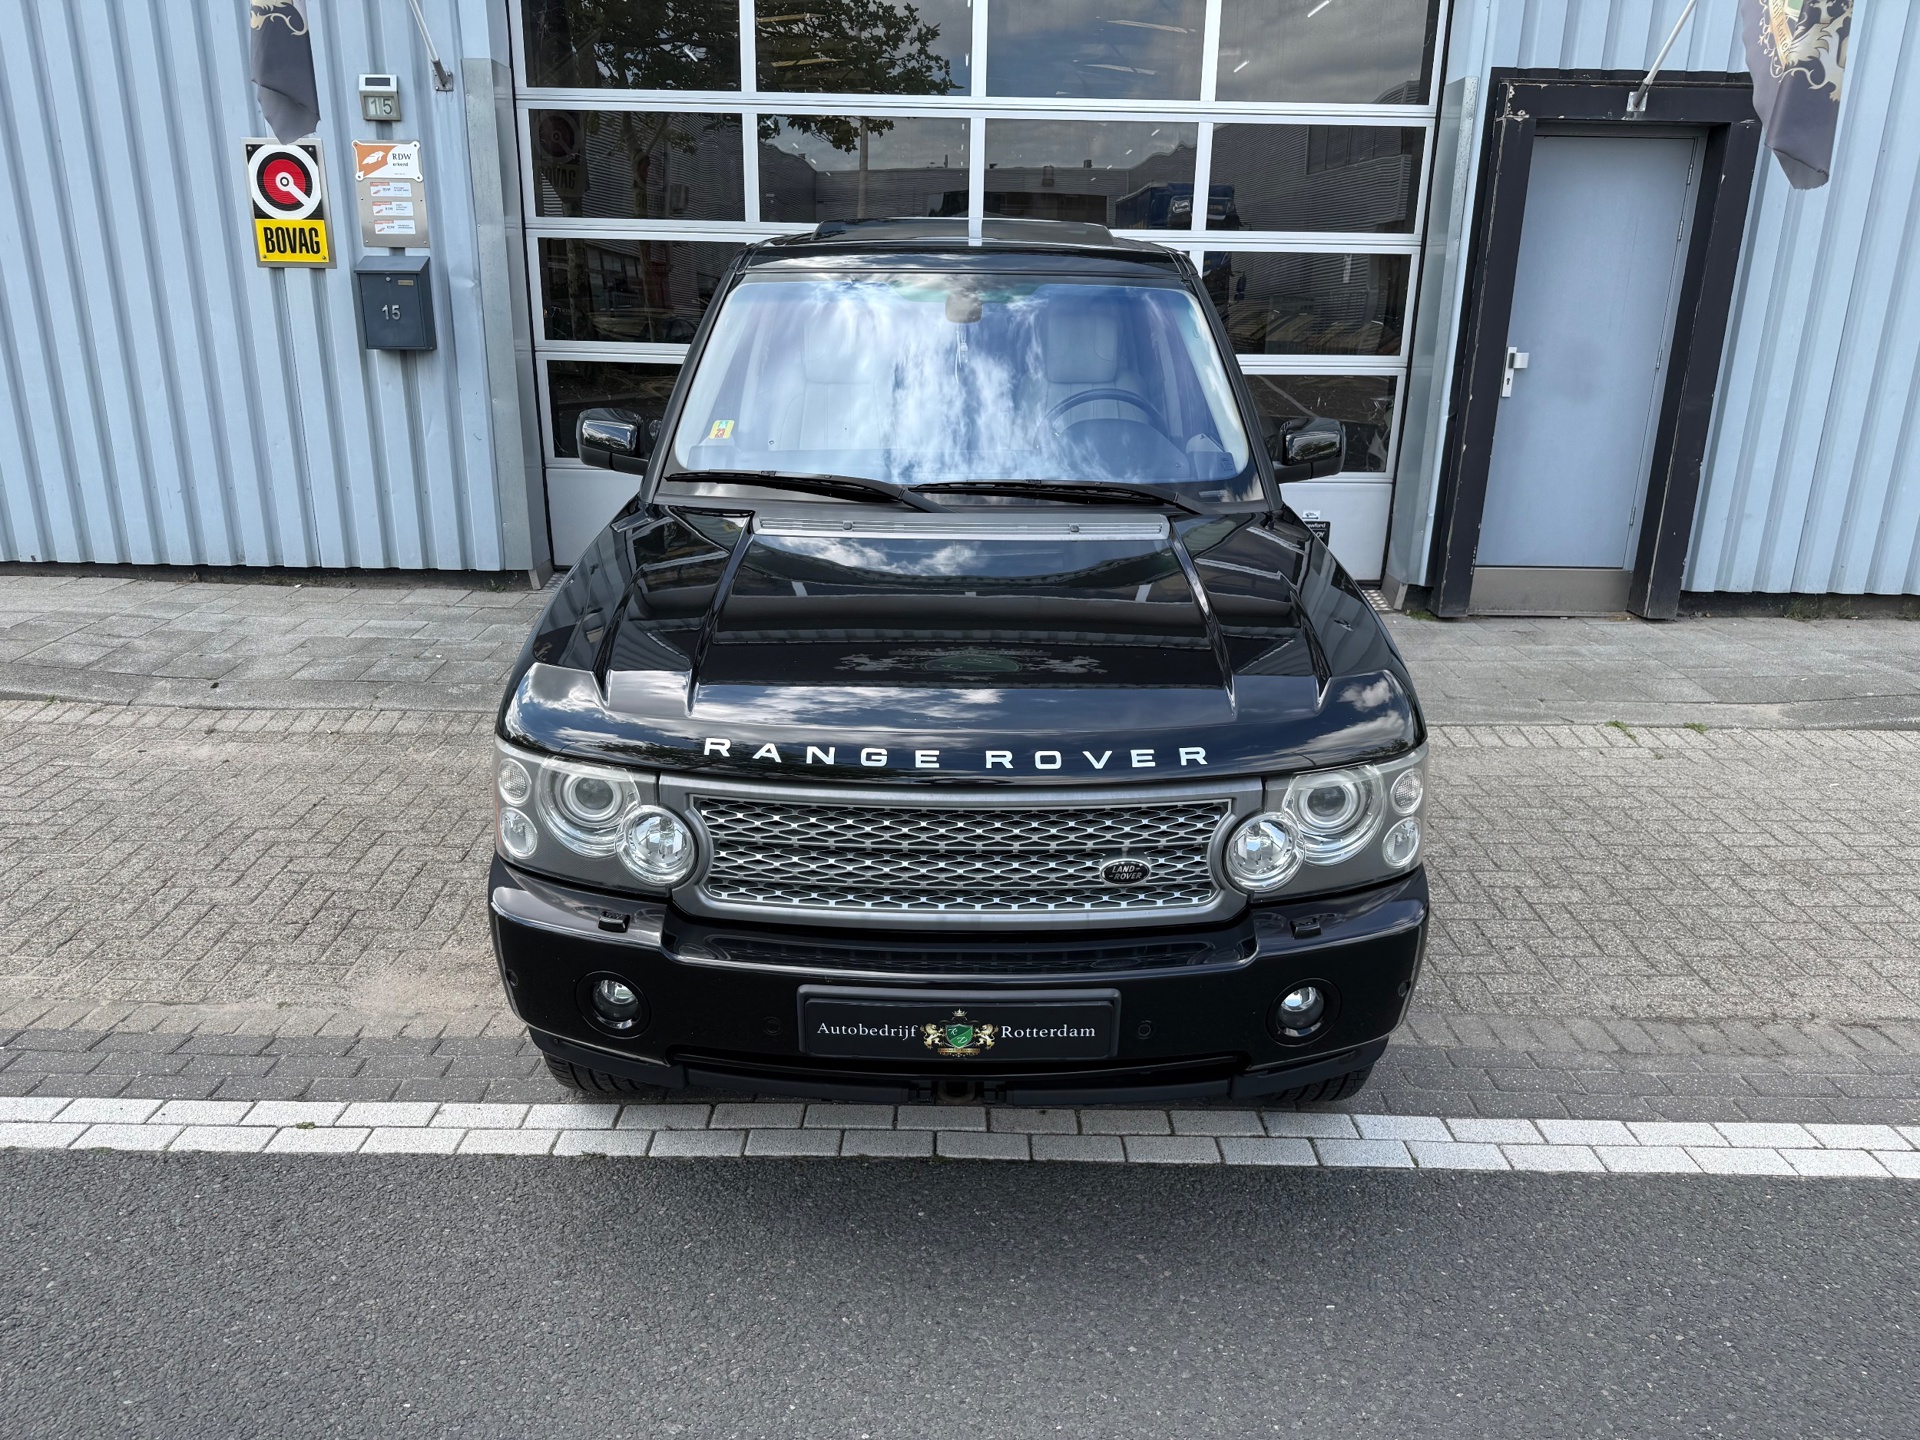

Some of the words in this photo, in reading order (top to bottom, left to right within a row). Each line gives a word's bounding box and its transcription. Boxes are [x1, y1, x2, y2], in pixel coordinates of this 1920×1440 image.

[371, 98, 393, 115] 15
[263, 226, 321, 255] BOVAG
[382, 304, 401, 321] 15
[703, 737, 940, 768] RANGE
[985, 746, 1208, 769] ROVER
[816, 1022, 918, 1040] Autobedrijf
[1001, 1024, 1096, 1038] Rotterdam
